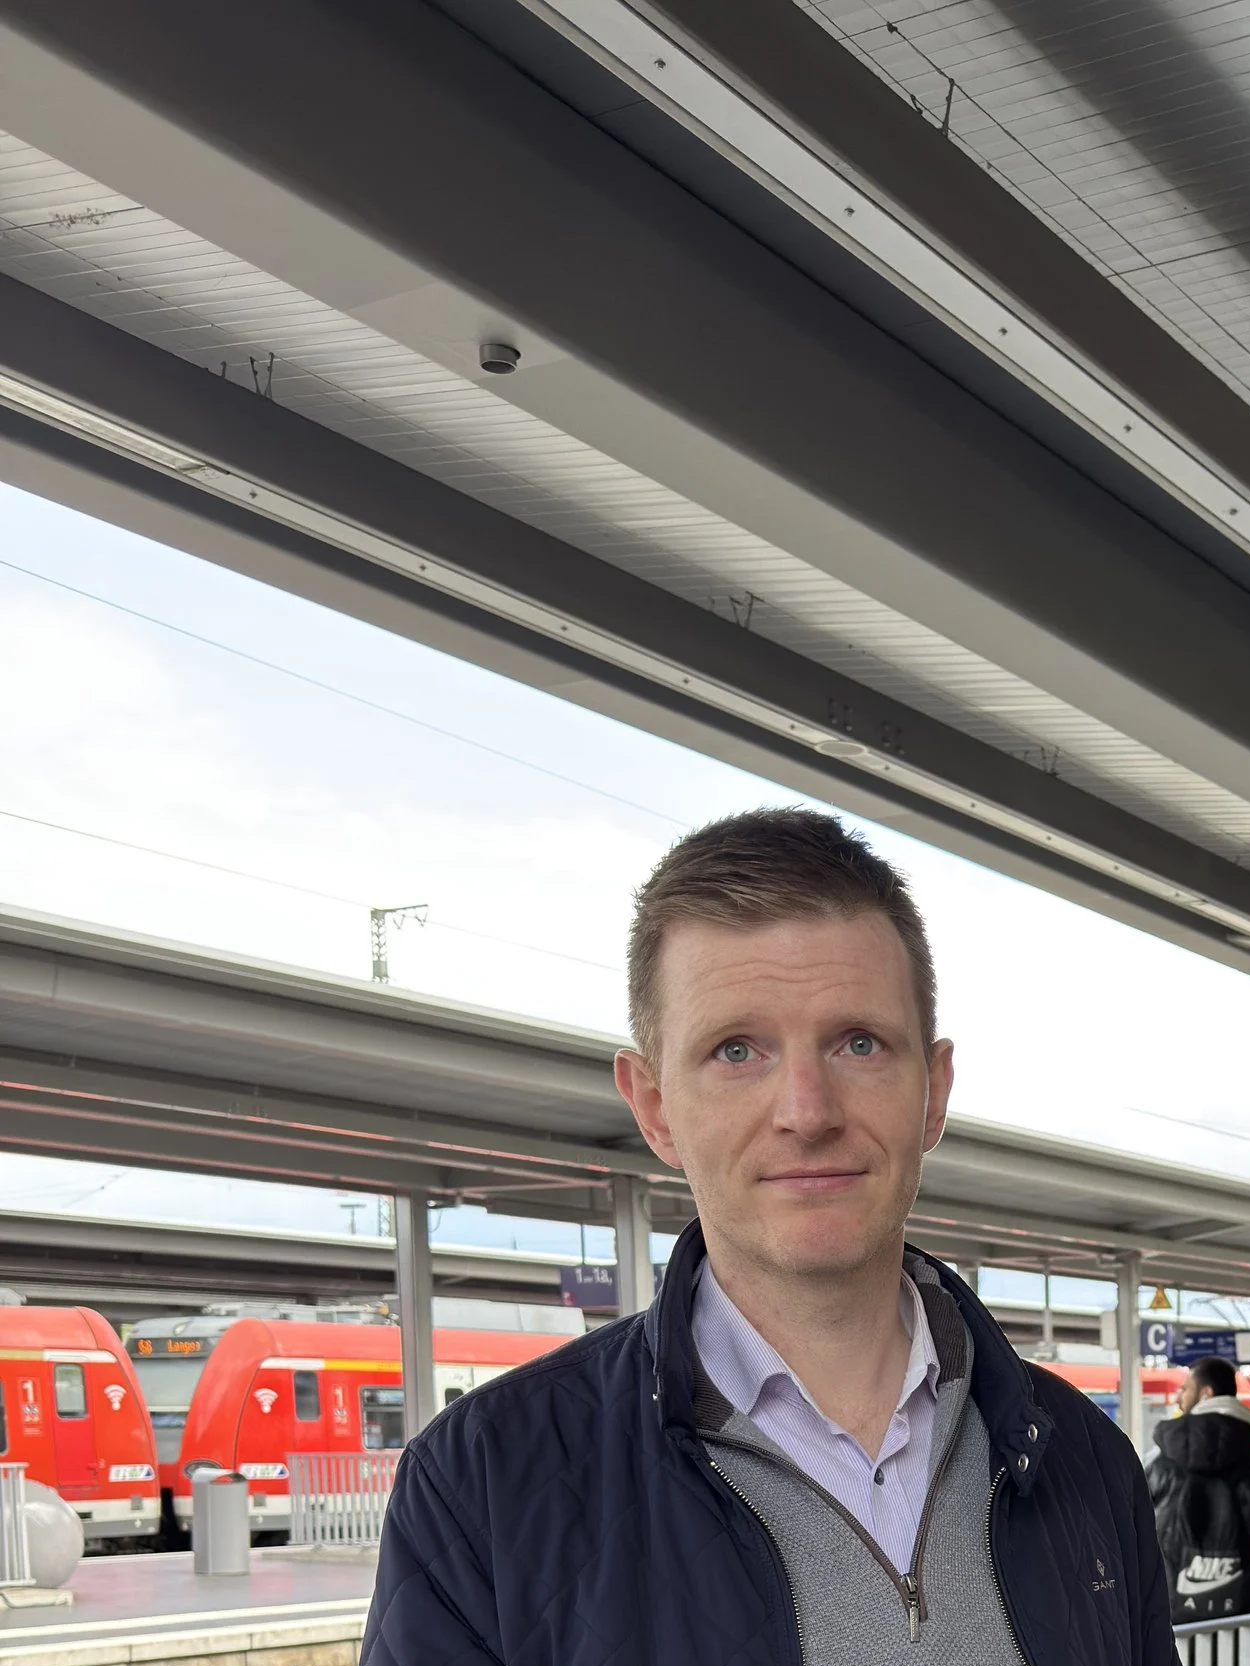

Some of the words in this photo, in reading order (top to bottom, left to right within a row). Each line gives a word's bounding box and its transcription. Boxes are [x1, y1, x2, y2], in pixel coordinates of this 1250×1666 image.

[1147, 1323, 1167, 1351] C
[22, 1380, 34, 1403] 1
[334, 1387, 344, 1408] 1
[1186, 1555, 1235, 1580] NIKE
[1092, 1579, 1116, 1592] GANT
